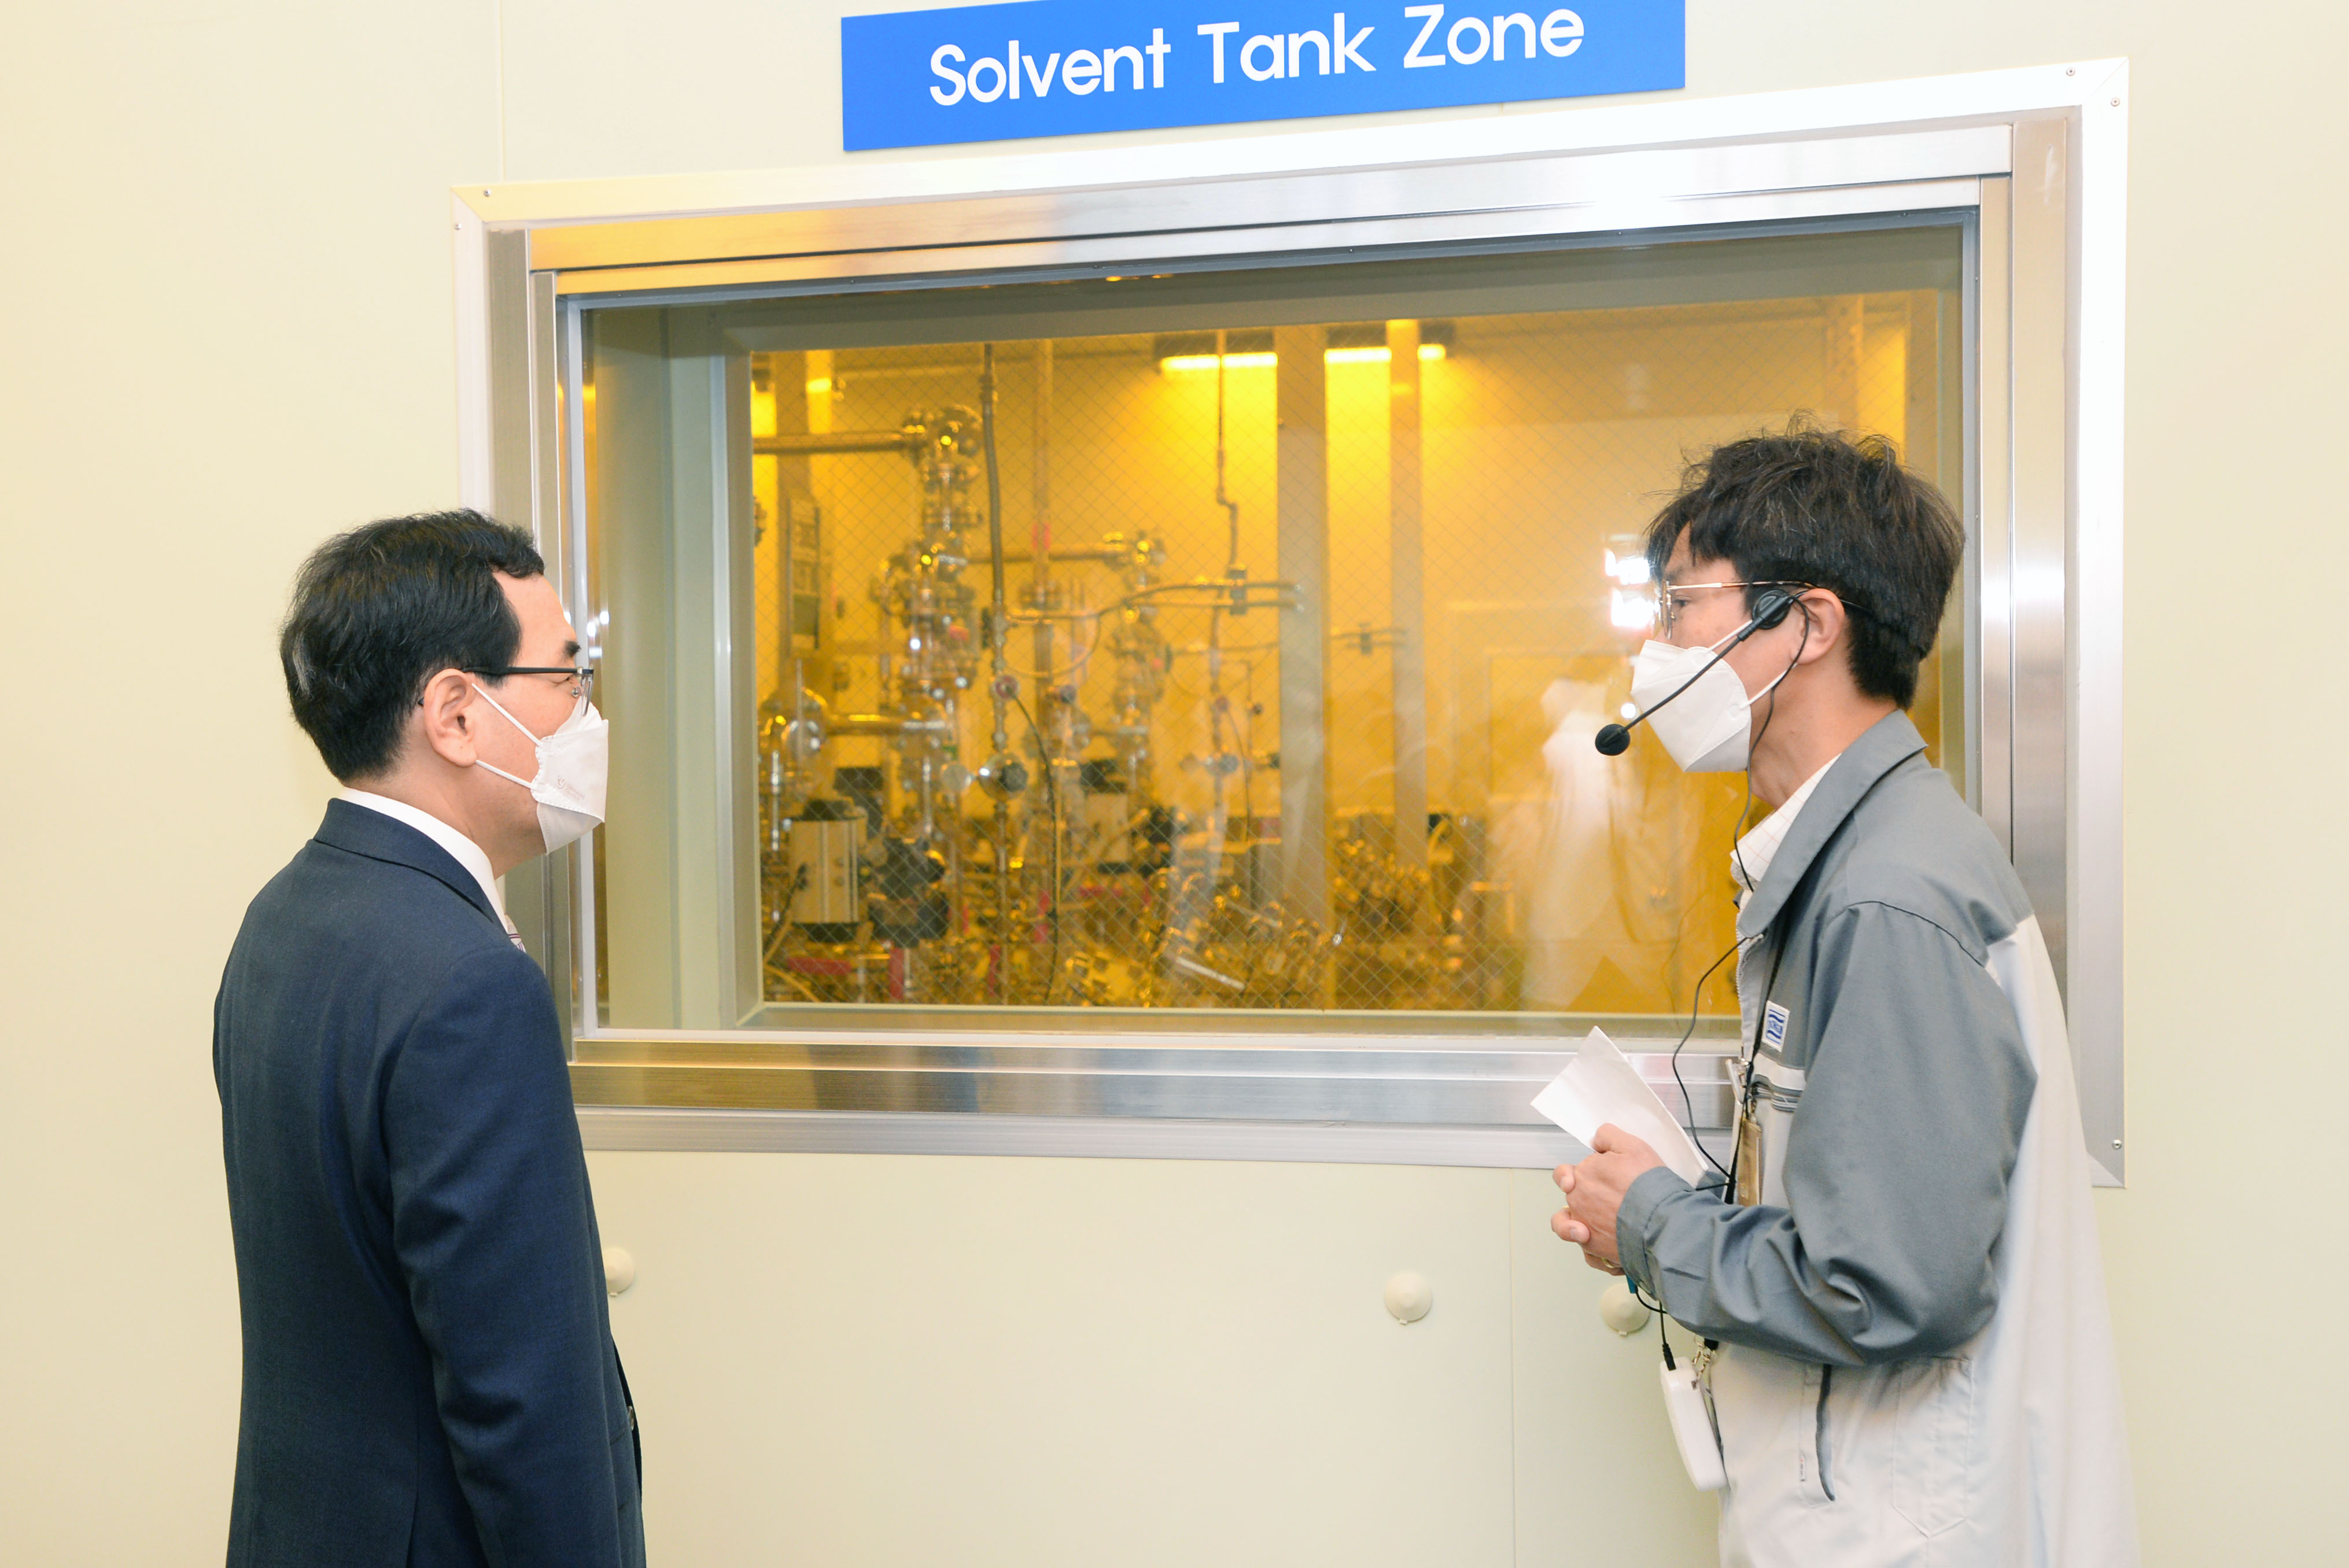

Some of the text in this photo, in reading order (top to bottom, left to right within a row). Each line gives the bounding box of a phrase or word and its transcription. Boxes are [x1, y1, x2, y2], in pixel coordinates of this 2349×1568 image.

[929, 3, 1585, 106] Solvent Tank Zone
